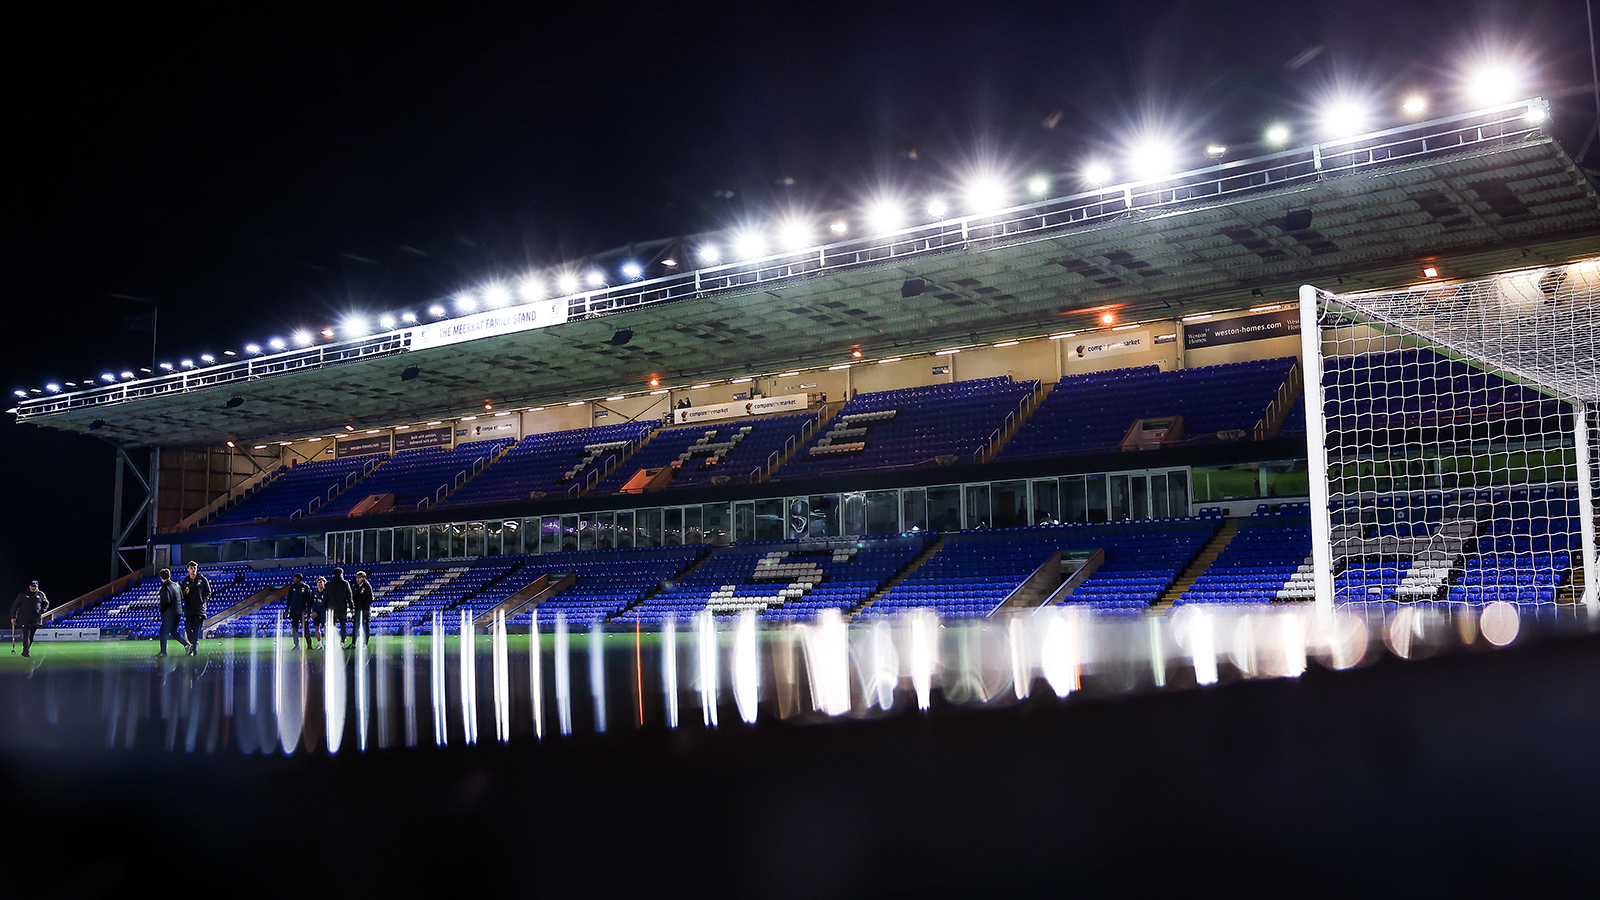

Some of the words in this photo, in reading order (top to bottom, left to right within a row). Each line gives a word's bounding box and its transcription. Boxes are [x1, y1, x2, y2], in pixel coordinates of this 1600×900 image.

[439, 327, 451, 338] THE
[453, 320, 485, 334] MEERKAT
[485, 316, 510, 329] FAMILY
[513, 310, 537, 324] STAND
[1214, 322, 1282, 337] weston-homes.com
[1188, 331, 1207, 340] Weston
[1188, 337, 1207, 345] Homes
